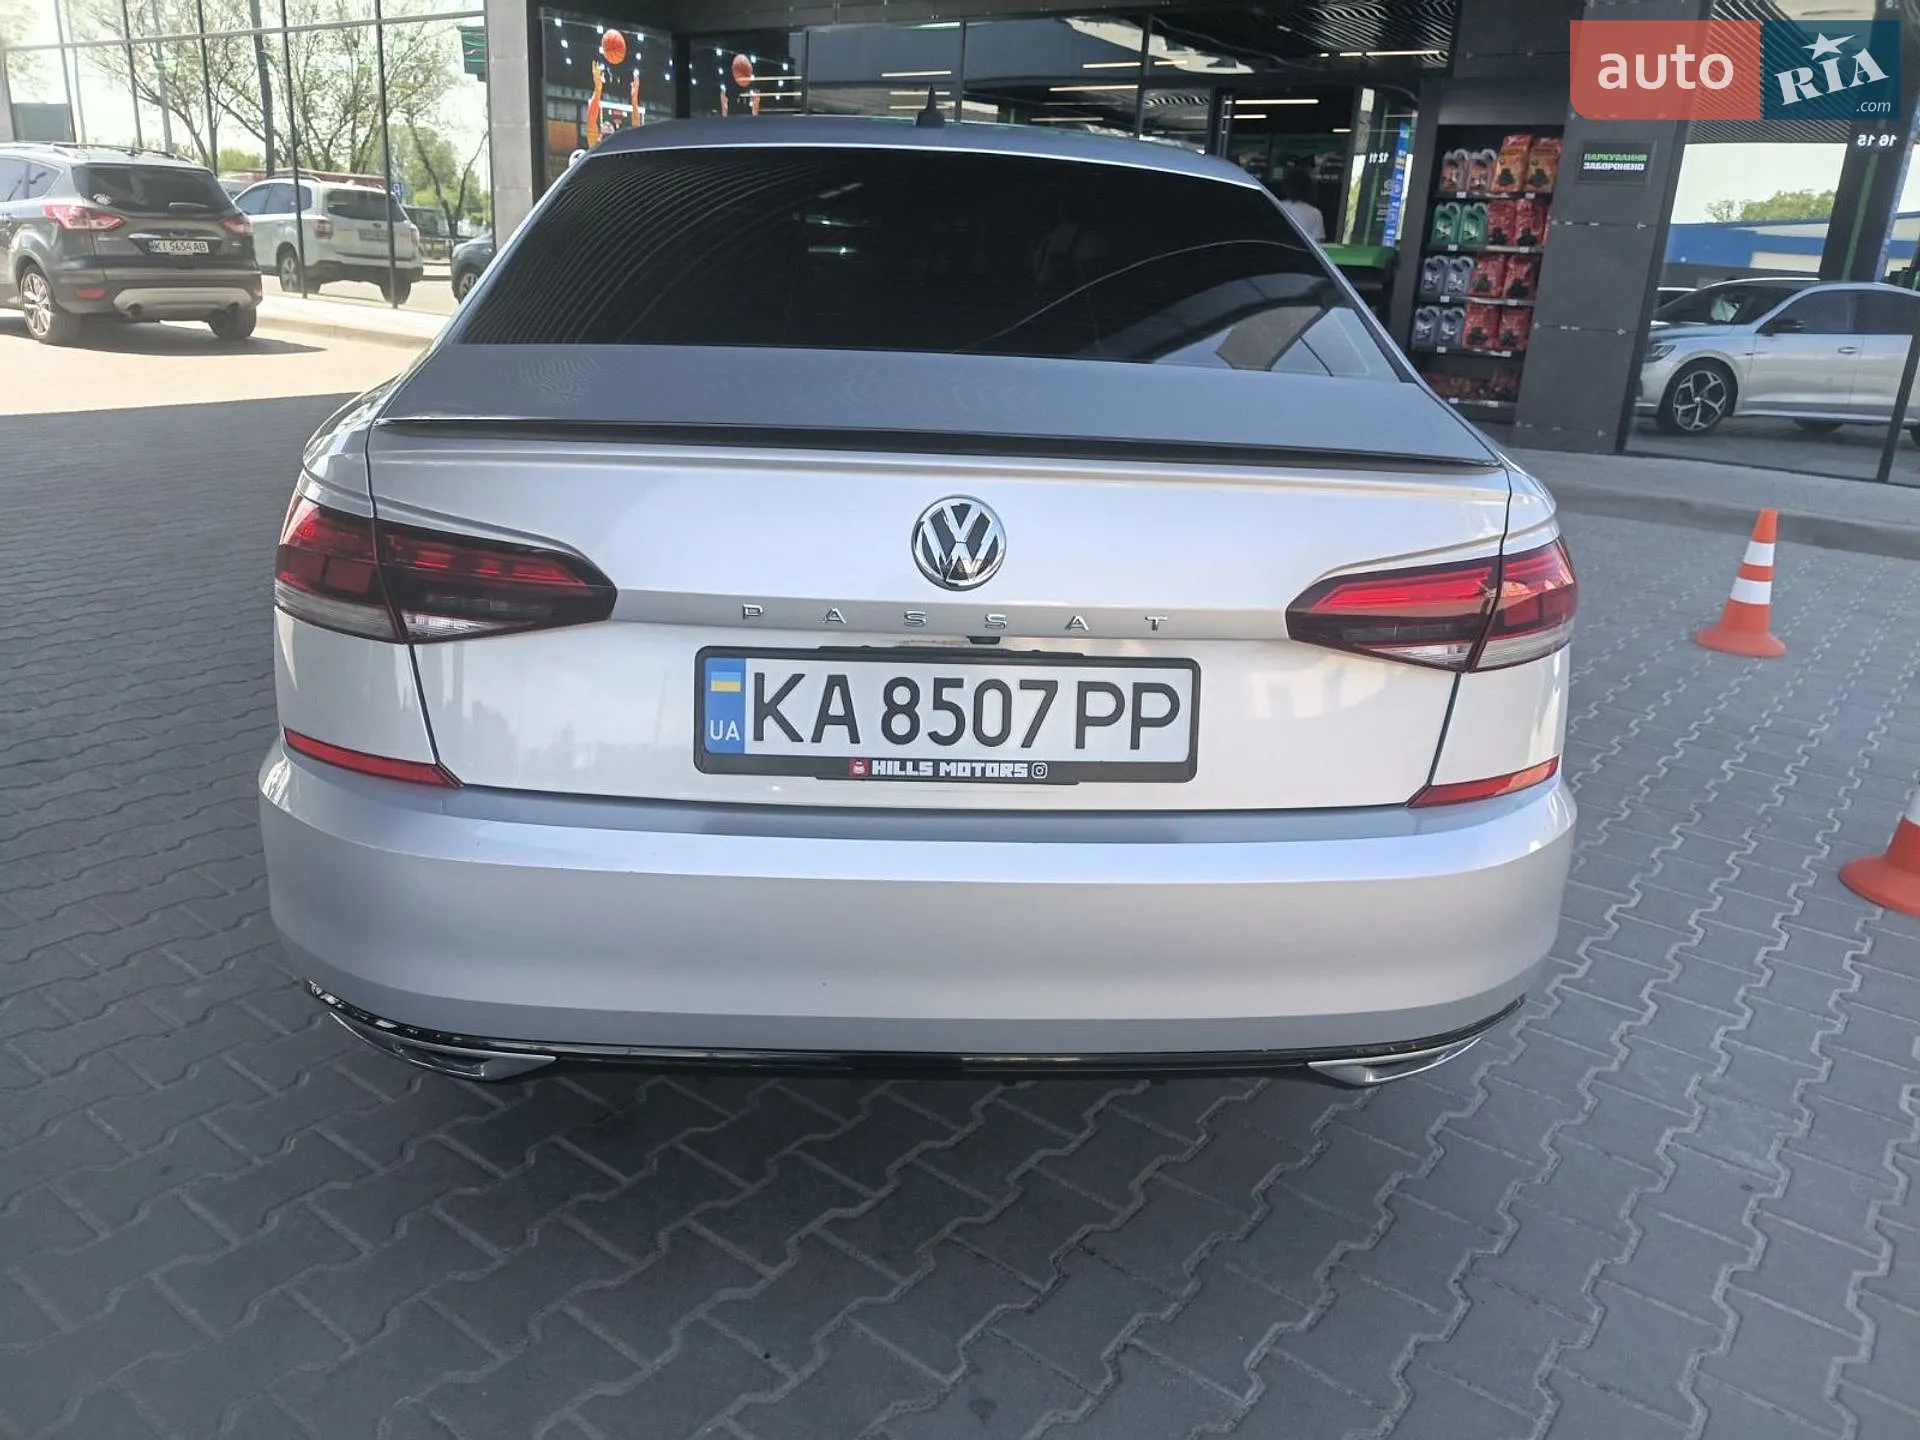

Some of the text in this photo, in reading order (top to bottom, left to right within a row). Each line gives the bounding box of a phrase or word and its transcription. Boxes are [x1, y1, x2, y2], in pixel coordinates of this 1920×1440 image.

[742, 603, 1168, 631] PASSAT
[752, 671, 1181, 751] KA 8507 PP
[709, 718, 740, 742] UA
[871, 760, 1028, 778] HILLS MOTORS
